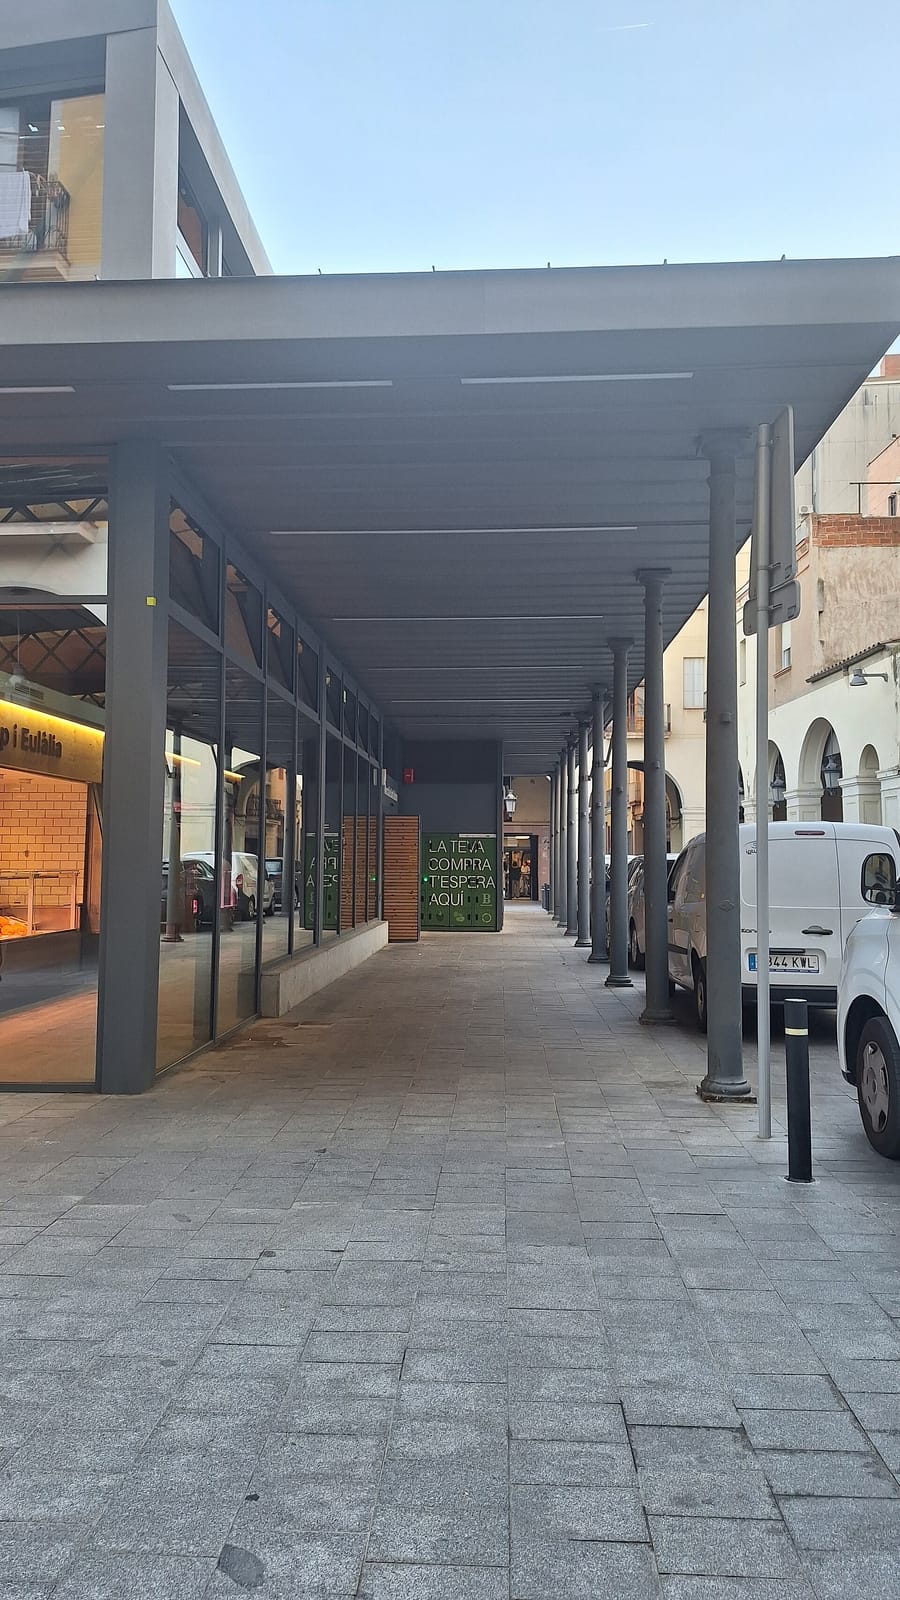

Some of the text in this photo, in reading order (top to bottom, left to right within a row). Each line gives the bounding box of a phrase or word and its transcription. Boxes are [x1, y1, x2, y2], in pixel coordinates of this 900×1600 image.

[13, 723, 18, 748] i
[428, 840, 485, 853] LA TEVA
[428, 857, 492, 871] COMPRA
[428, 875, 496, 889] T'ESPERA
[428, 890, 464, 907] AQUÍ
[792, 957, 815, 969] KWL
